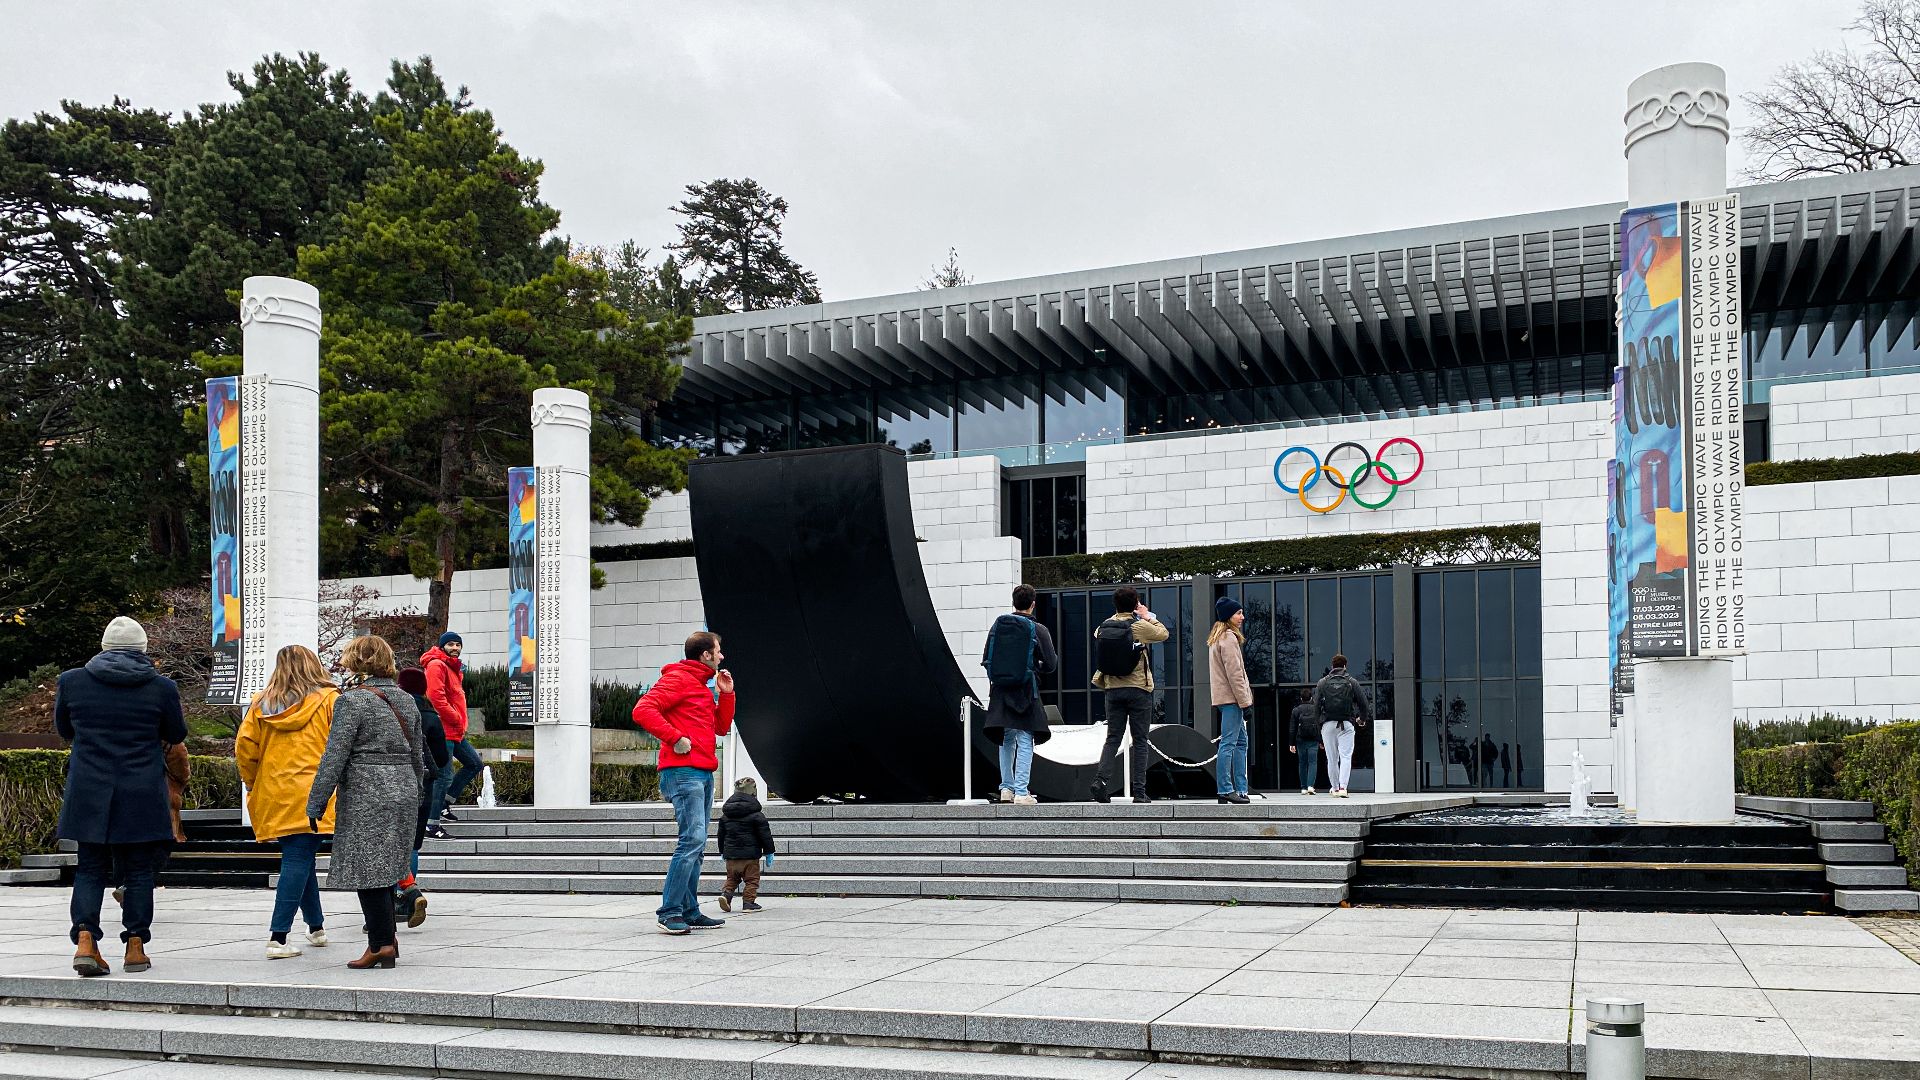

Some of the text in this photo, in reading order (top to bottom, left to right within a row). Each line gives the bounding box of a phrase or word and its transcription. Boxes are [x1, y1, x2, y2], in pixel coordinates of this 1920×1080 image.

[1633, 612, 1679, 620] 05.03.2023
[1692, 204, 1710, 649] RIDING THE OLYMPIC WAVE RIDING THE OLYMPIC WAVE
[1709, 202, 1727, 648] RIDING THE OLYMPIC WAVE RIDING THE OLYMPIC WAVE
[1726, 199, 1744, 648] RIDING THE OLYMPIC WAVE RIDING THE OLYMPIC WAVE
[241, 660, 250, 699] RIDING
